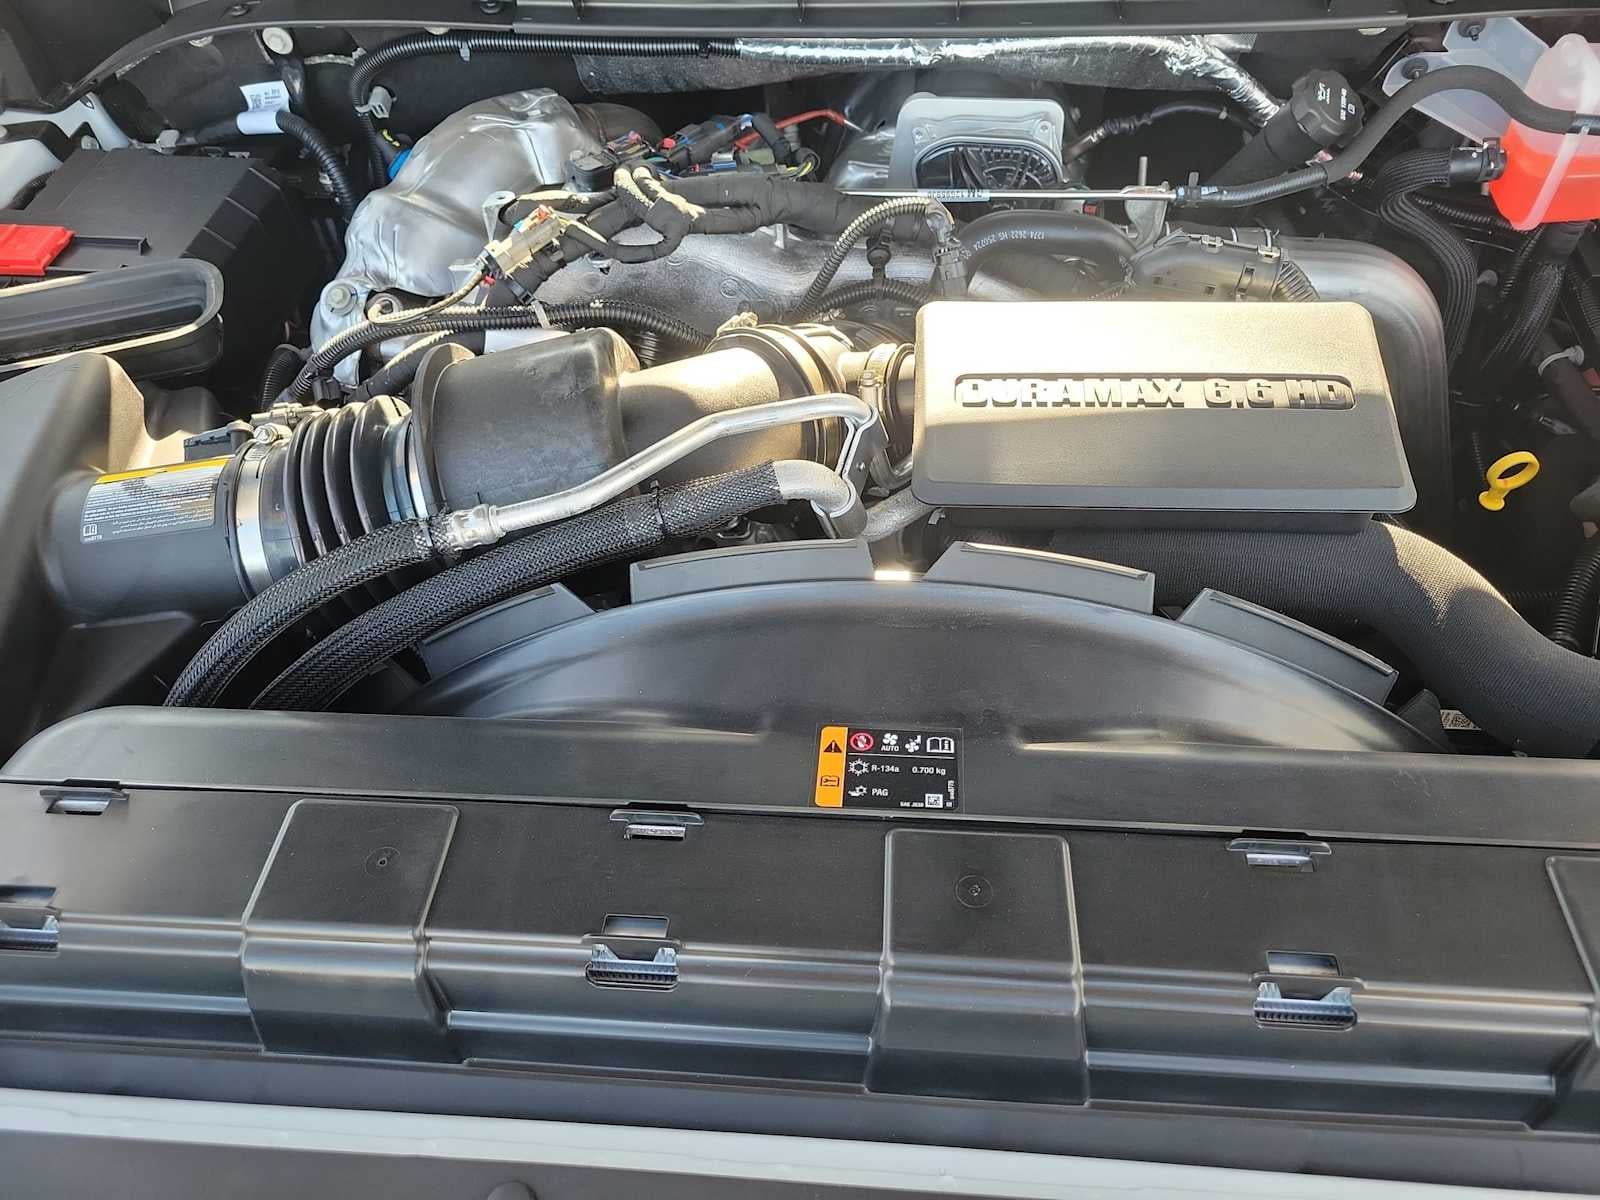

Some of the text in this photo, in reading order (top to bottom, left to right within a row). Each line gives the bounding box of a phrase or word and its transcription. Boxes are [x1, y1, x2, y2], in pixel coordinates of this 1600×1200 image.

[960, 378, 1354, 410] DURAMAX 6.6 HD
[871, 764, 946, 776] R-134a 0.700 kg
